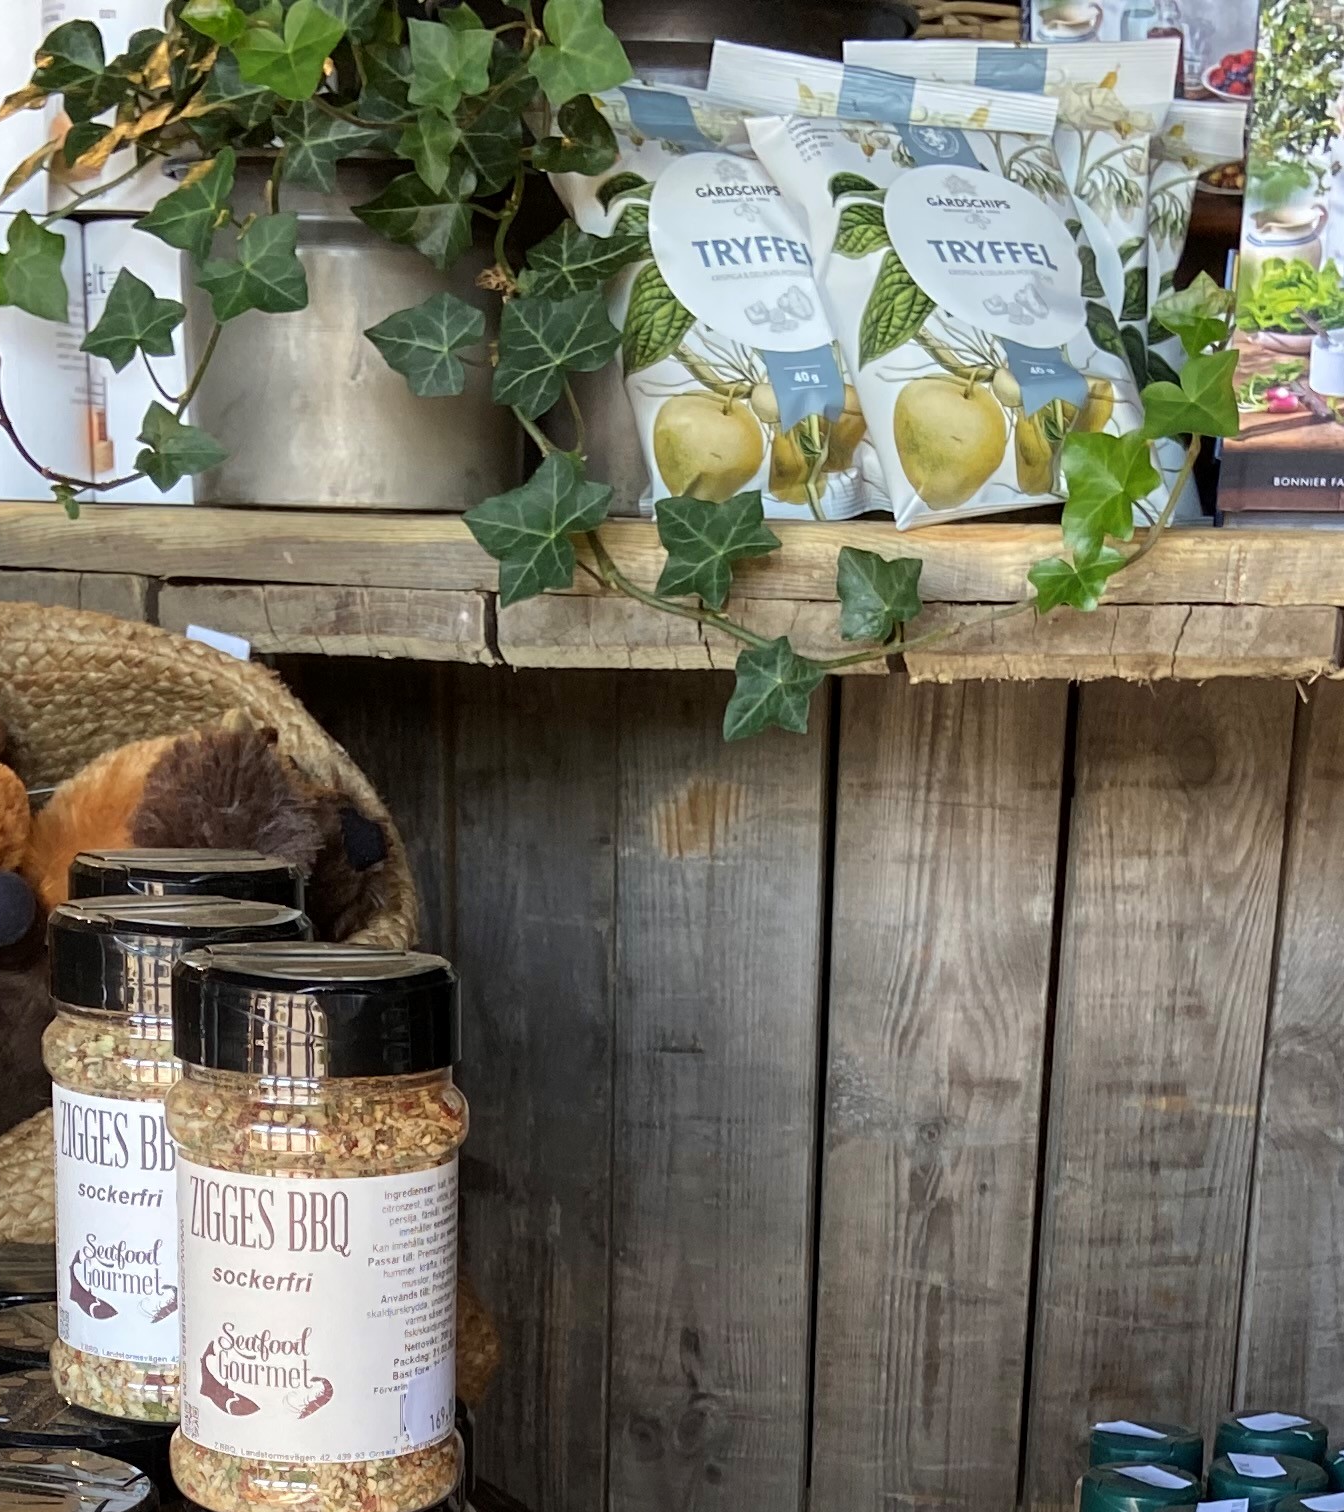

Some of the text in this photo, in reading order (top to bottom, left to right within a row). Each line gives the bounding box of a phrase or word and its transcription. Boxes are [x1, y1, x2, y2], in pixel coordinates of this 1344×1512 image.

[926, 239, 1059, 272] TRYFFEL
[793, 370, 807, 383] 40
[1273, 476, 1327, 488] BONNIER
[60, 1100, 129, 1169] ZIGGES
[77, 1181, 164, 1208] sockerfri
[190, 1174, 352, 1258] ZIGGES BBQ
[82, 1233, 163, 1267] Seafood
[367, 1255, 400, 1267] Passar
[82, 1263, 166, 1298] Gourmet
[212, 1266, 314, 1293] sockerfri
[380, 1290, 418, 1305] Används
[218, 1321, 313, 1363] Seafood
[217, 1350, 315, 1389] Gourmet
